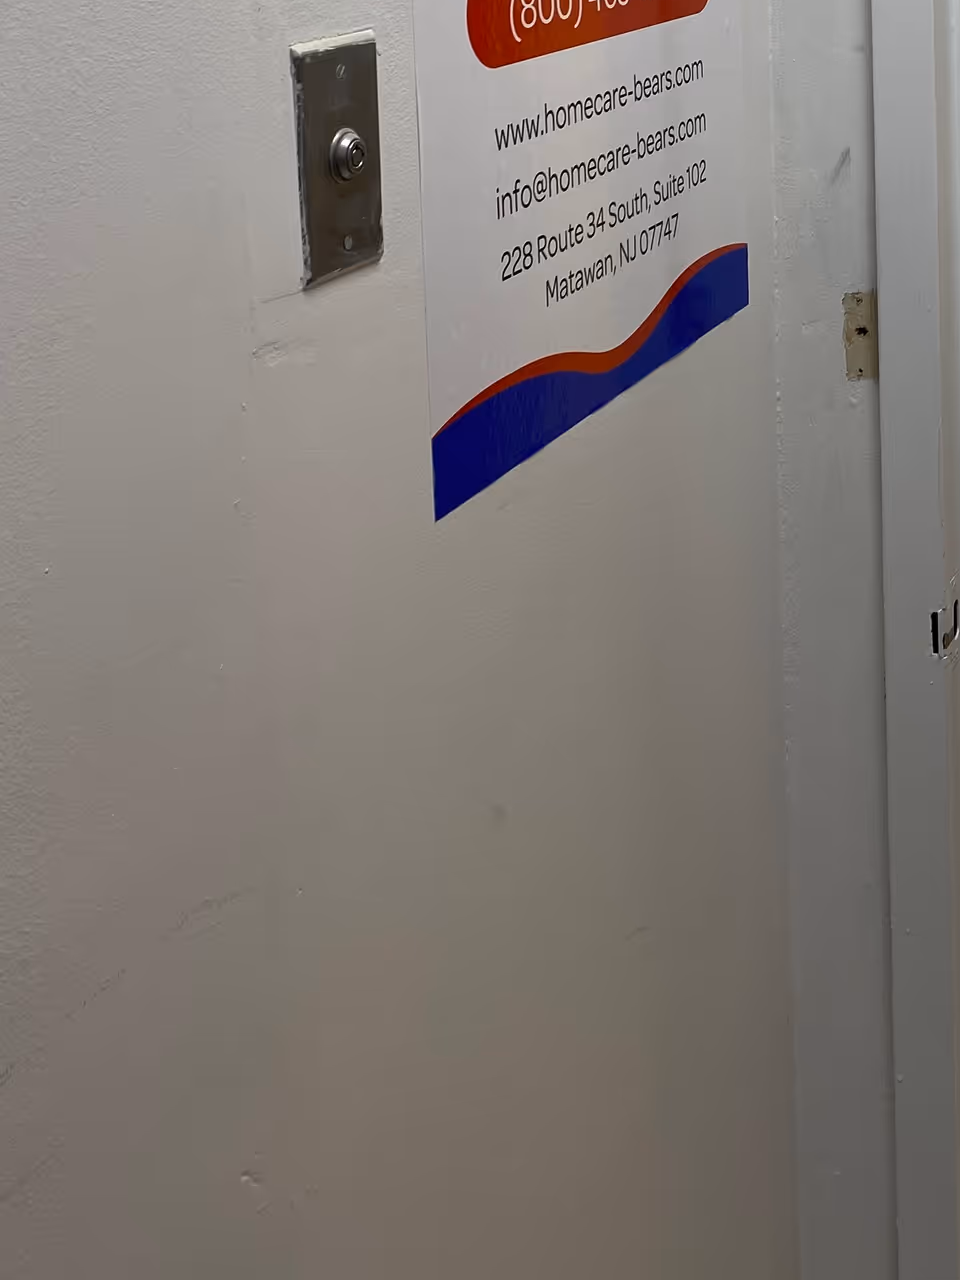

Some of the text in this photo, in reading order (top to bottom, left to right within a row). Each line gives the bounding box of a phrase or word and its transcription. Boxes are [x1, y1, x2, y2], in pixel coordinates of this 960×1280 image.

[494, 58, 705, 151] www.homecare-bears.com
[495, 112, 707, 220] info@homecare-bears.com
[501, 159, 707, 282] 228 Route 34 South, Suite 102
[546, 212, 679, 308] Matawan, NJ 07747
